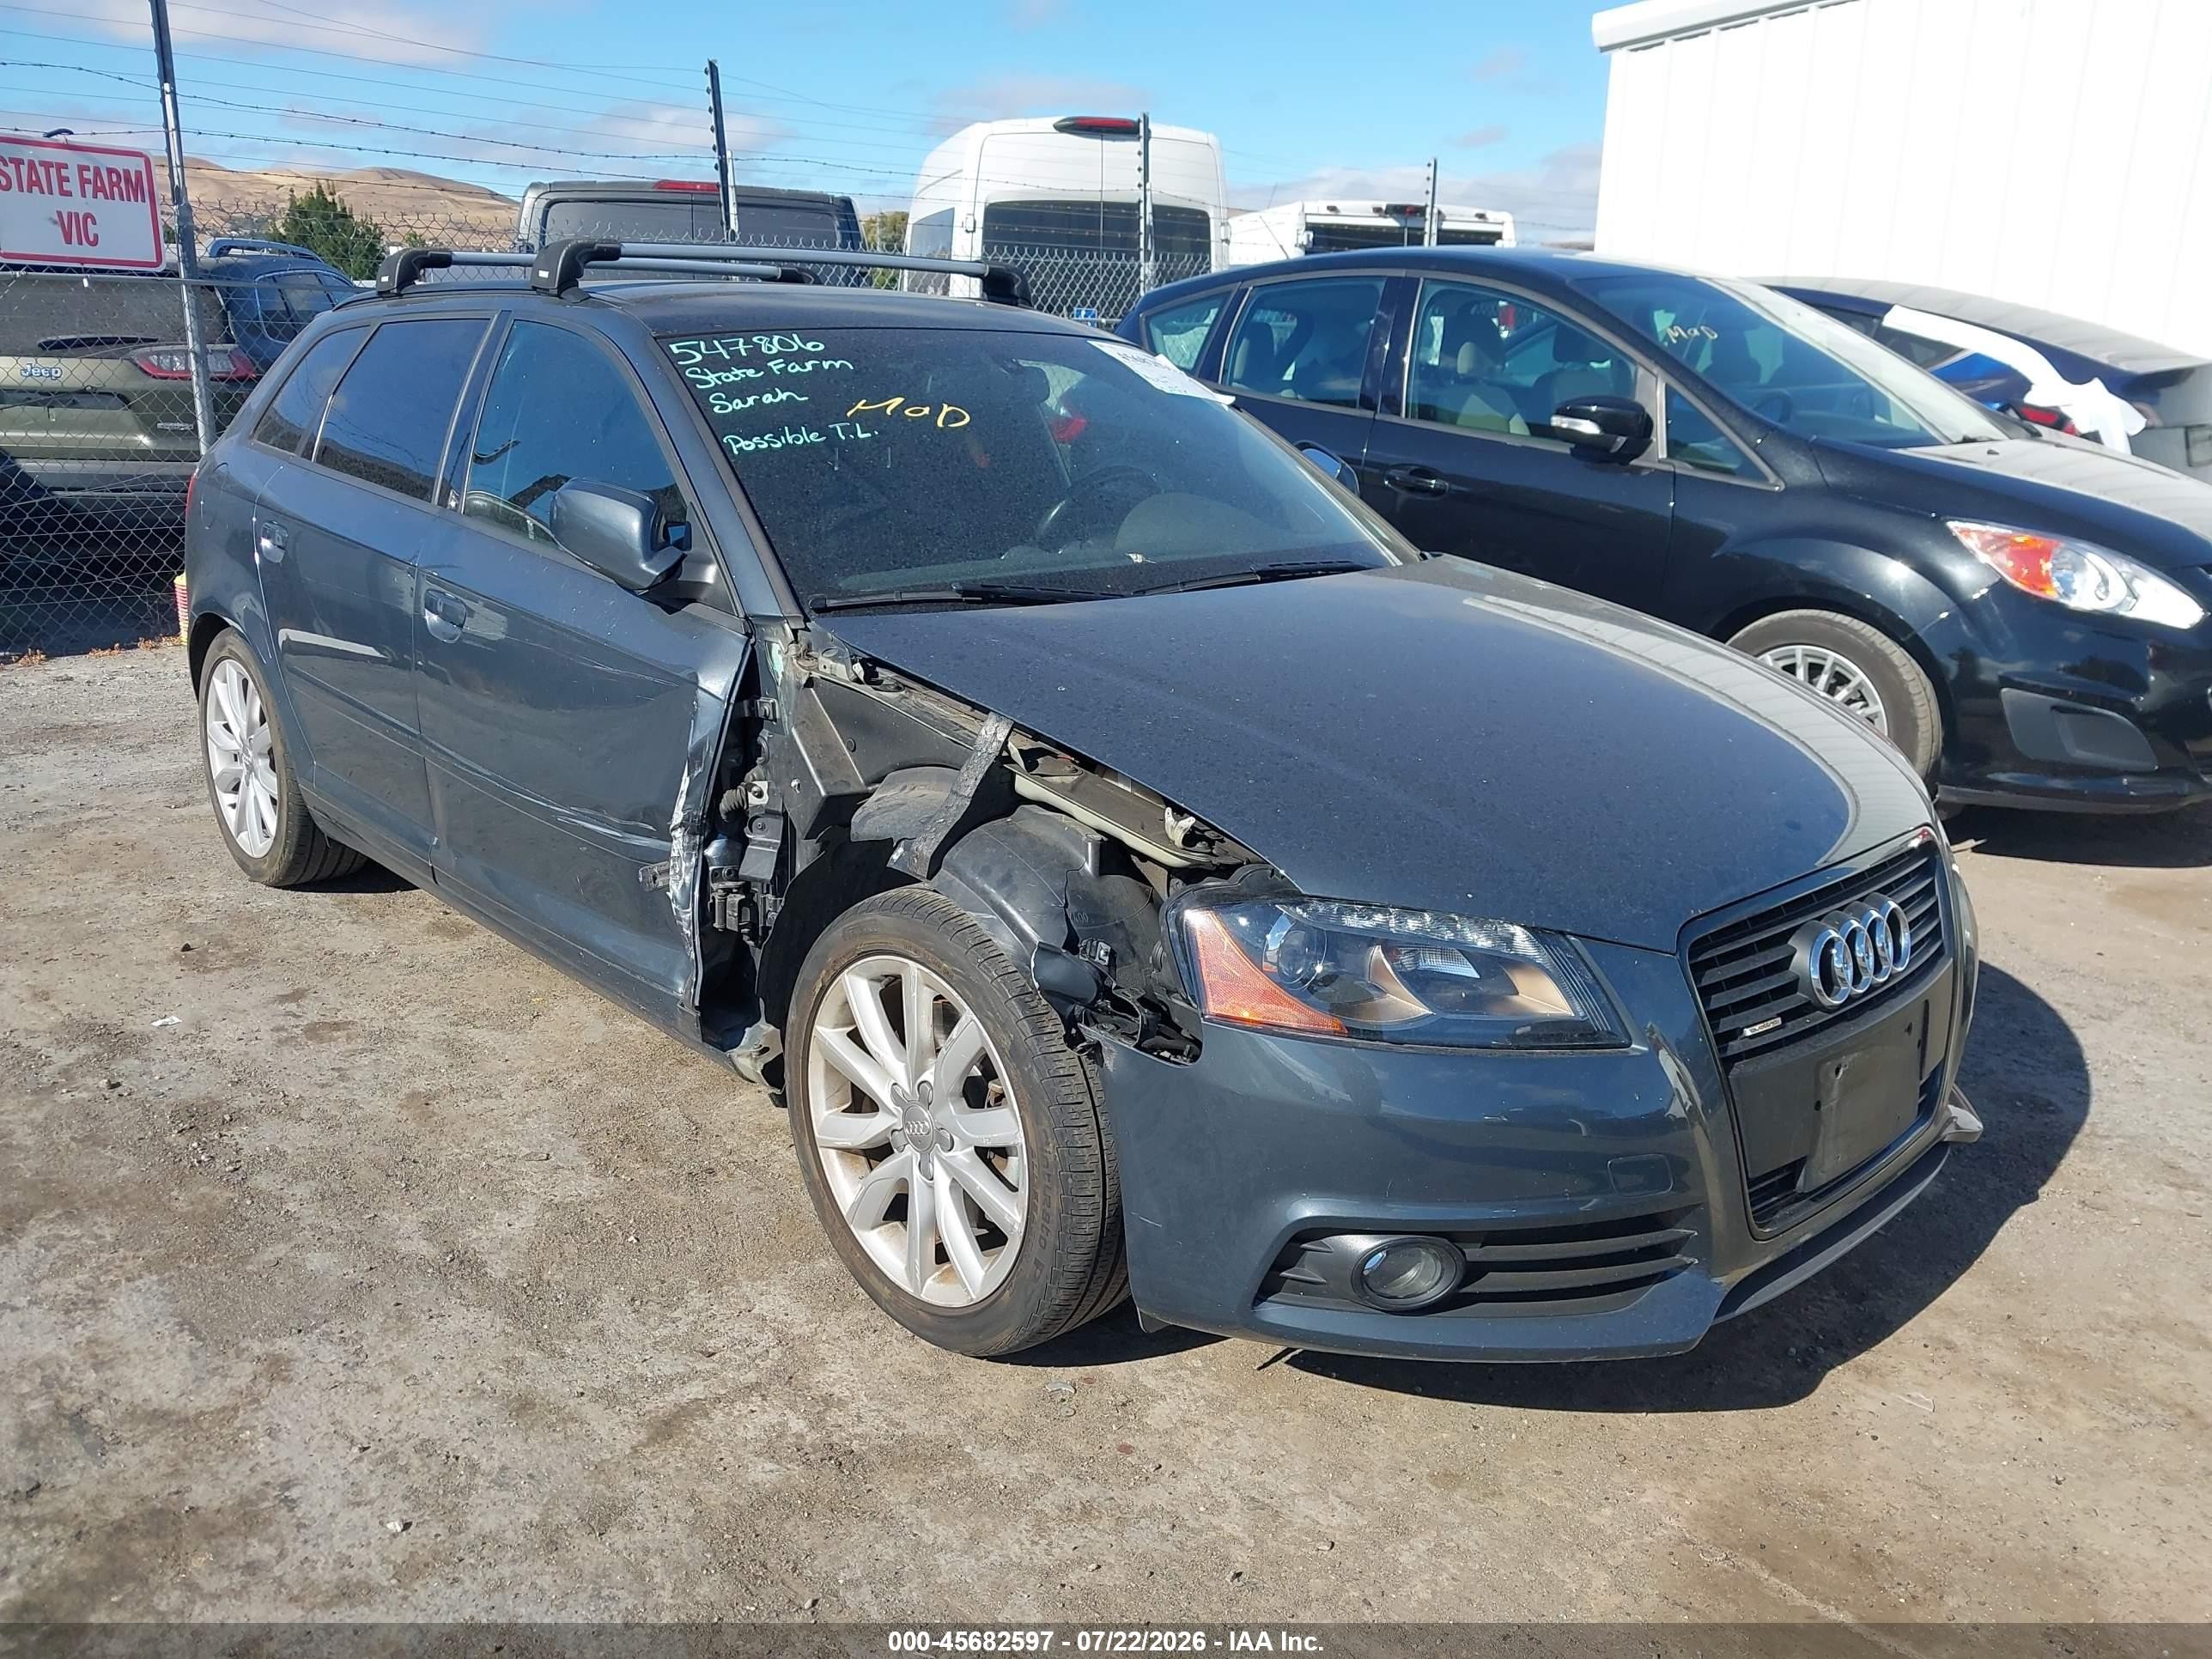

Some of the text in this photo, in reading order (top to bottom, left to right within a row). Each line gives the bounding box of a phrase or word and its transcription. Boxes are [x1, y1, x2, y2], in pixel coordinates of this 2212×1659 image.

[0, 155, 146, 203] STATE FARM
[56, 210, 99, 246] VIC
[669, 333, 825, 364] 547806
[21, 362, 63, 380] Jeep
[685, 358, 854, 388] State Farm
[708, 387, 810, 414] Sarah
[723, 426, 827, 455] Possible
